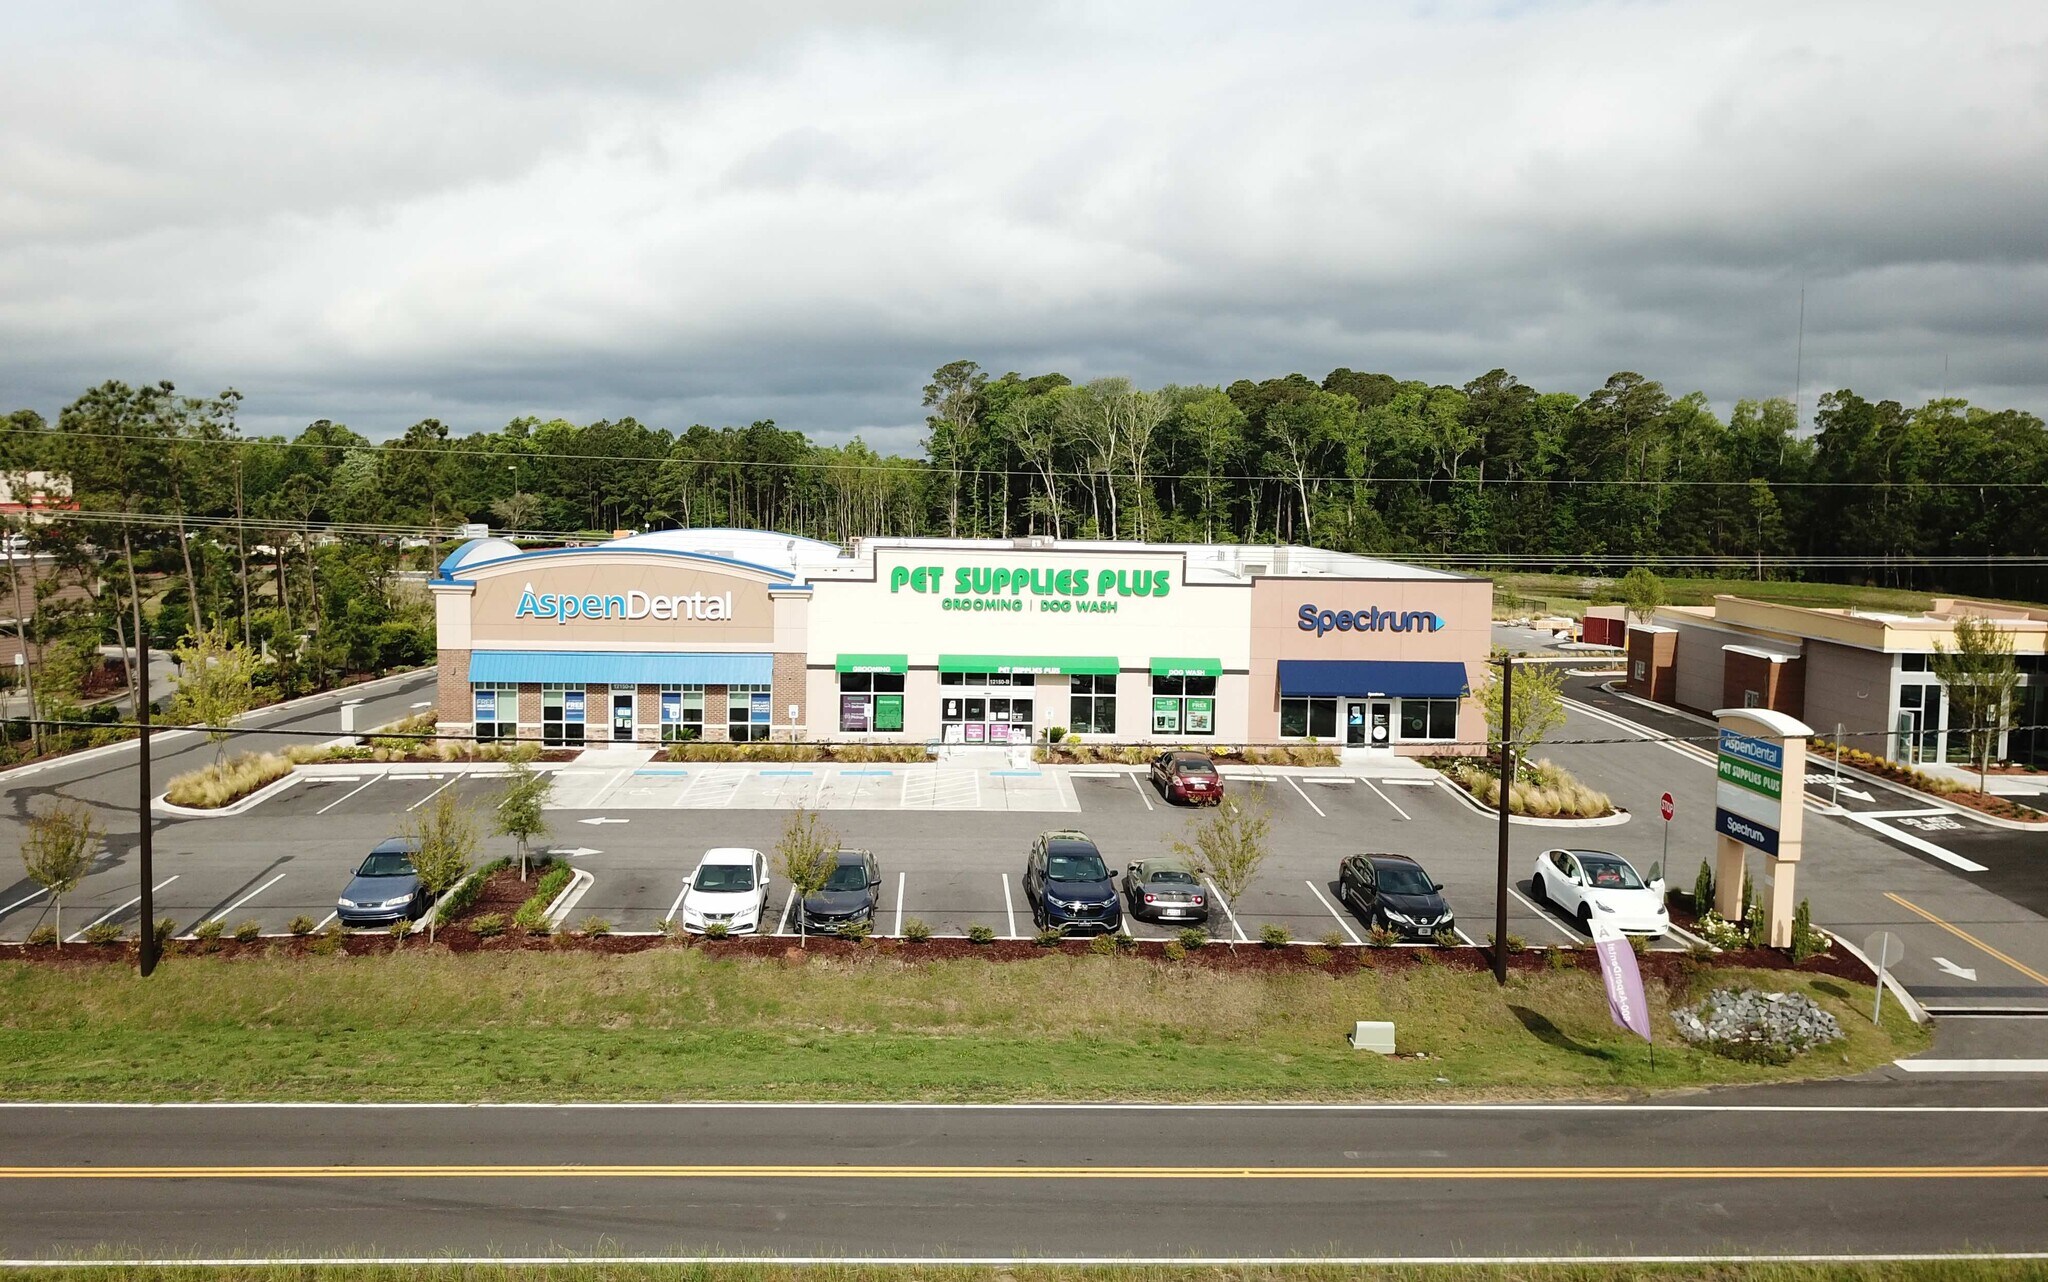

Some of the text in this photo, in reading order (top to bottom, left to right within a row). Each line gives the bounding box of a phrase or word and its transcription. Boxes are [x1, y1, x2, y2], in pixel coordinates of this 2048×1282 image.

[890, 566, 1171, 598] PET SUPPLIES PLUS
[515, 583, 733, 625] AspenDental
[942, 598, 1118, 614] GROOMING DOG WASH
[1297, 604, 1436, 638] Spectrum
[1719, 760, 1780, 792] PET SUPPLIES PLUS
[1661, 799, 1673, 814] STOP
[1726, 816, 1765, 843] Spectrum
